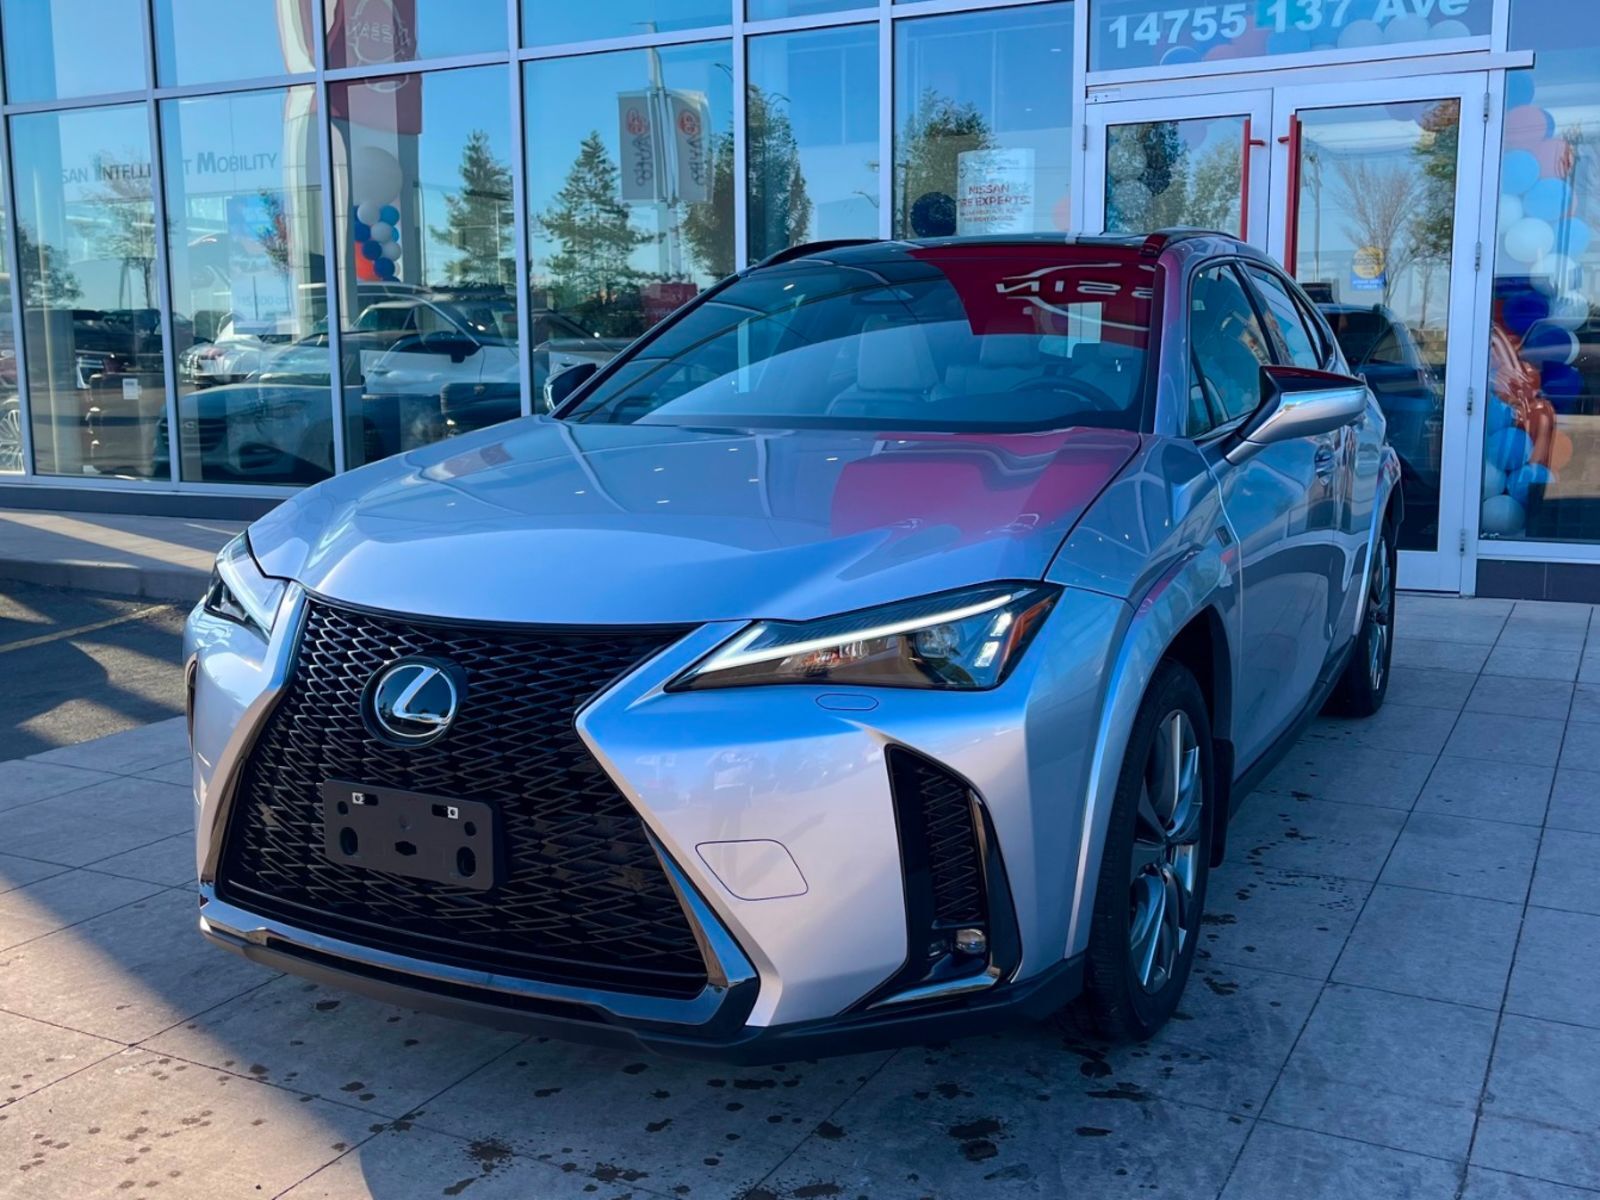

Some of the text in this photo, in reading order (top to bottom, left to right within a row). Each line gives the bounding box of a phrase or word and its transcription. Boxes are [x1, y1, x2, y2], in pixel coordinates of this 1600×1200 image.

[1109, 0, 1469, 48] 14755 137 Ave
[197, 151, 277, 174] MOBILITY
[968, 184, 1010, 195] NISSAN
